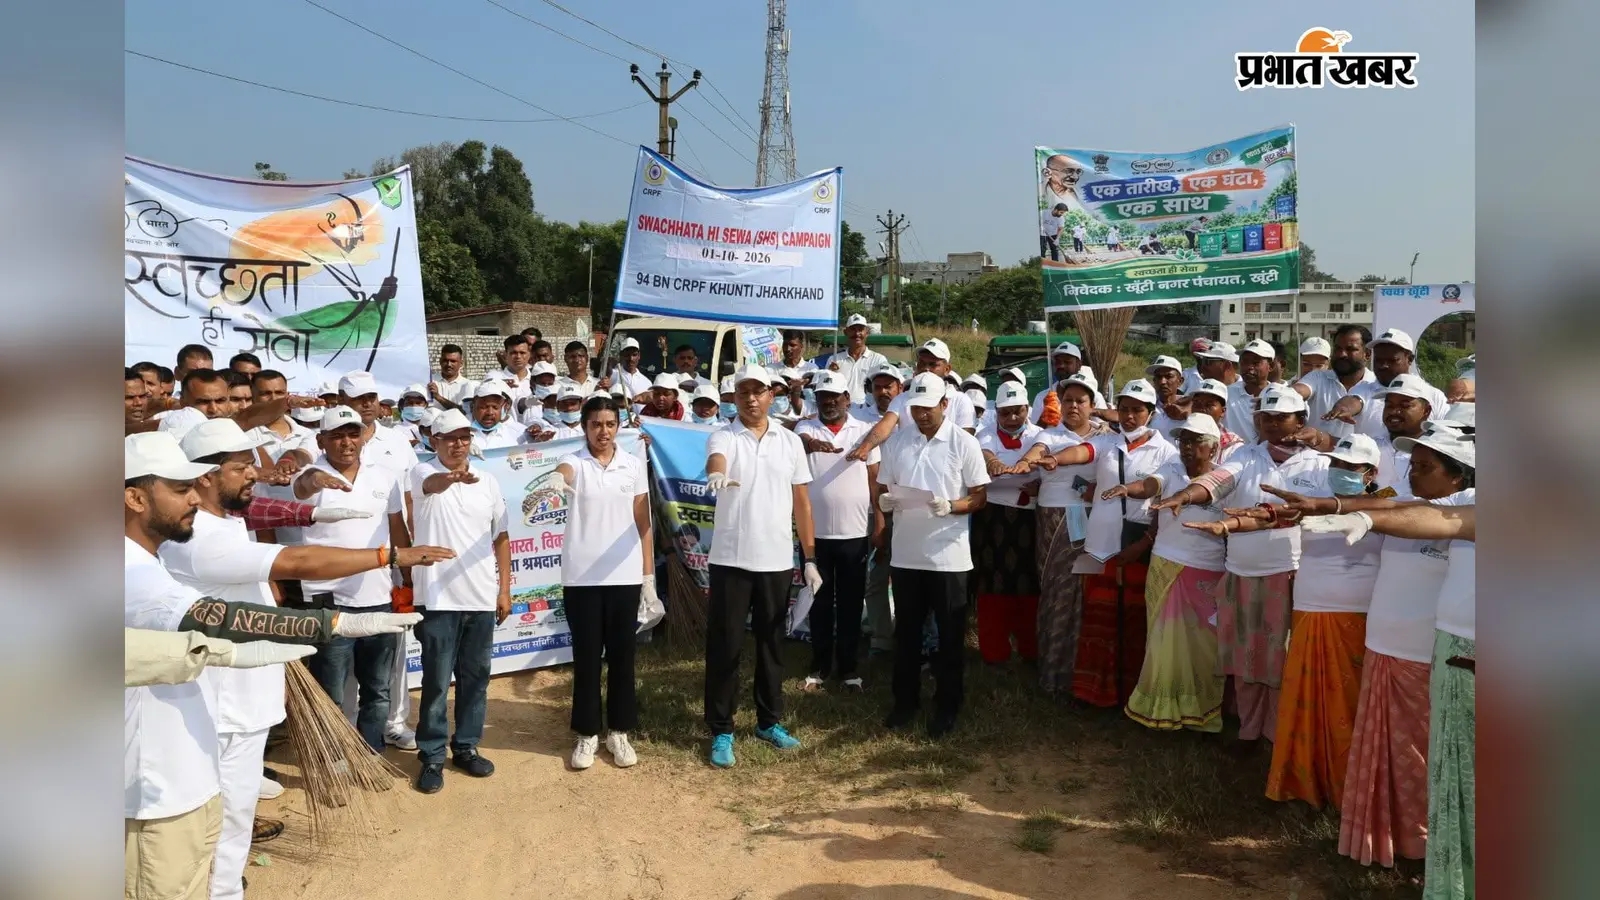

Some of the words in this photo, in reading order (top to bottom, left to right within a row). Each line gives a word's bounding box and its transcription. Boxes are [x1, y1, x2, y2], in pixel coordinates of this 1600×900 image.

[642, 188, 662, 197] CRPF
[1091, 183, 1121, 199] एक
[1125, 177, 1178, 195] तारीख,
[1188, 175, 1217, 190] एक
[1222, 170, 1259, 186] घंटा,
[1116, 200, 1157, 217] एक
[1162, 195, 1212, 213] साथ
[145, 219, 169, 229] भारत
[638, 214, 704, 238] SWACHHATA
[708, 226, 719, 241] HI
[723, 227, 753, 245] SEWA
[753, 231, 779, 249] (SHS)
[782, 231, 831, 248] CAMPAIGN
[744, 251, 771, 264] 2026
[1168, 265, 1177, 274] ही
[1180, 264, 1198, 273] सेवा
[636, 273, 650, 286] 94
[653, 275, 670, 289] BN
[673, 278, 706, 293] CRPF
[709, 282, 753, 298] KHUNTI
[756, 286, 824, 301] JHARKHAND
[1062, 283, 1112, 296] निवेदक
[1157, 279, 1190, 290] नगर
[1192, 274, 1246, 288] पंचायत,
[199, 306, 232, 346] ही
[233, 313, 320, 370] सेवा
[678, 481, 706, 497] स्वच्छ
[229, 608, 322, 638] OPEN
